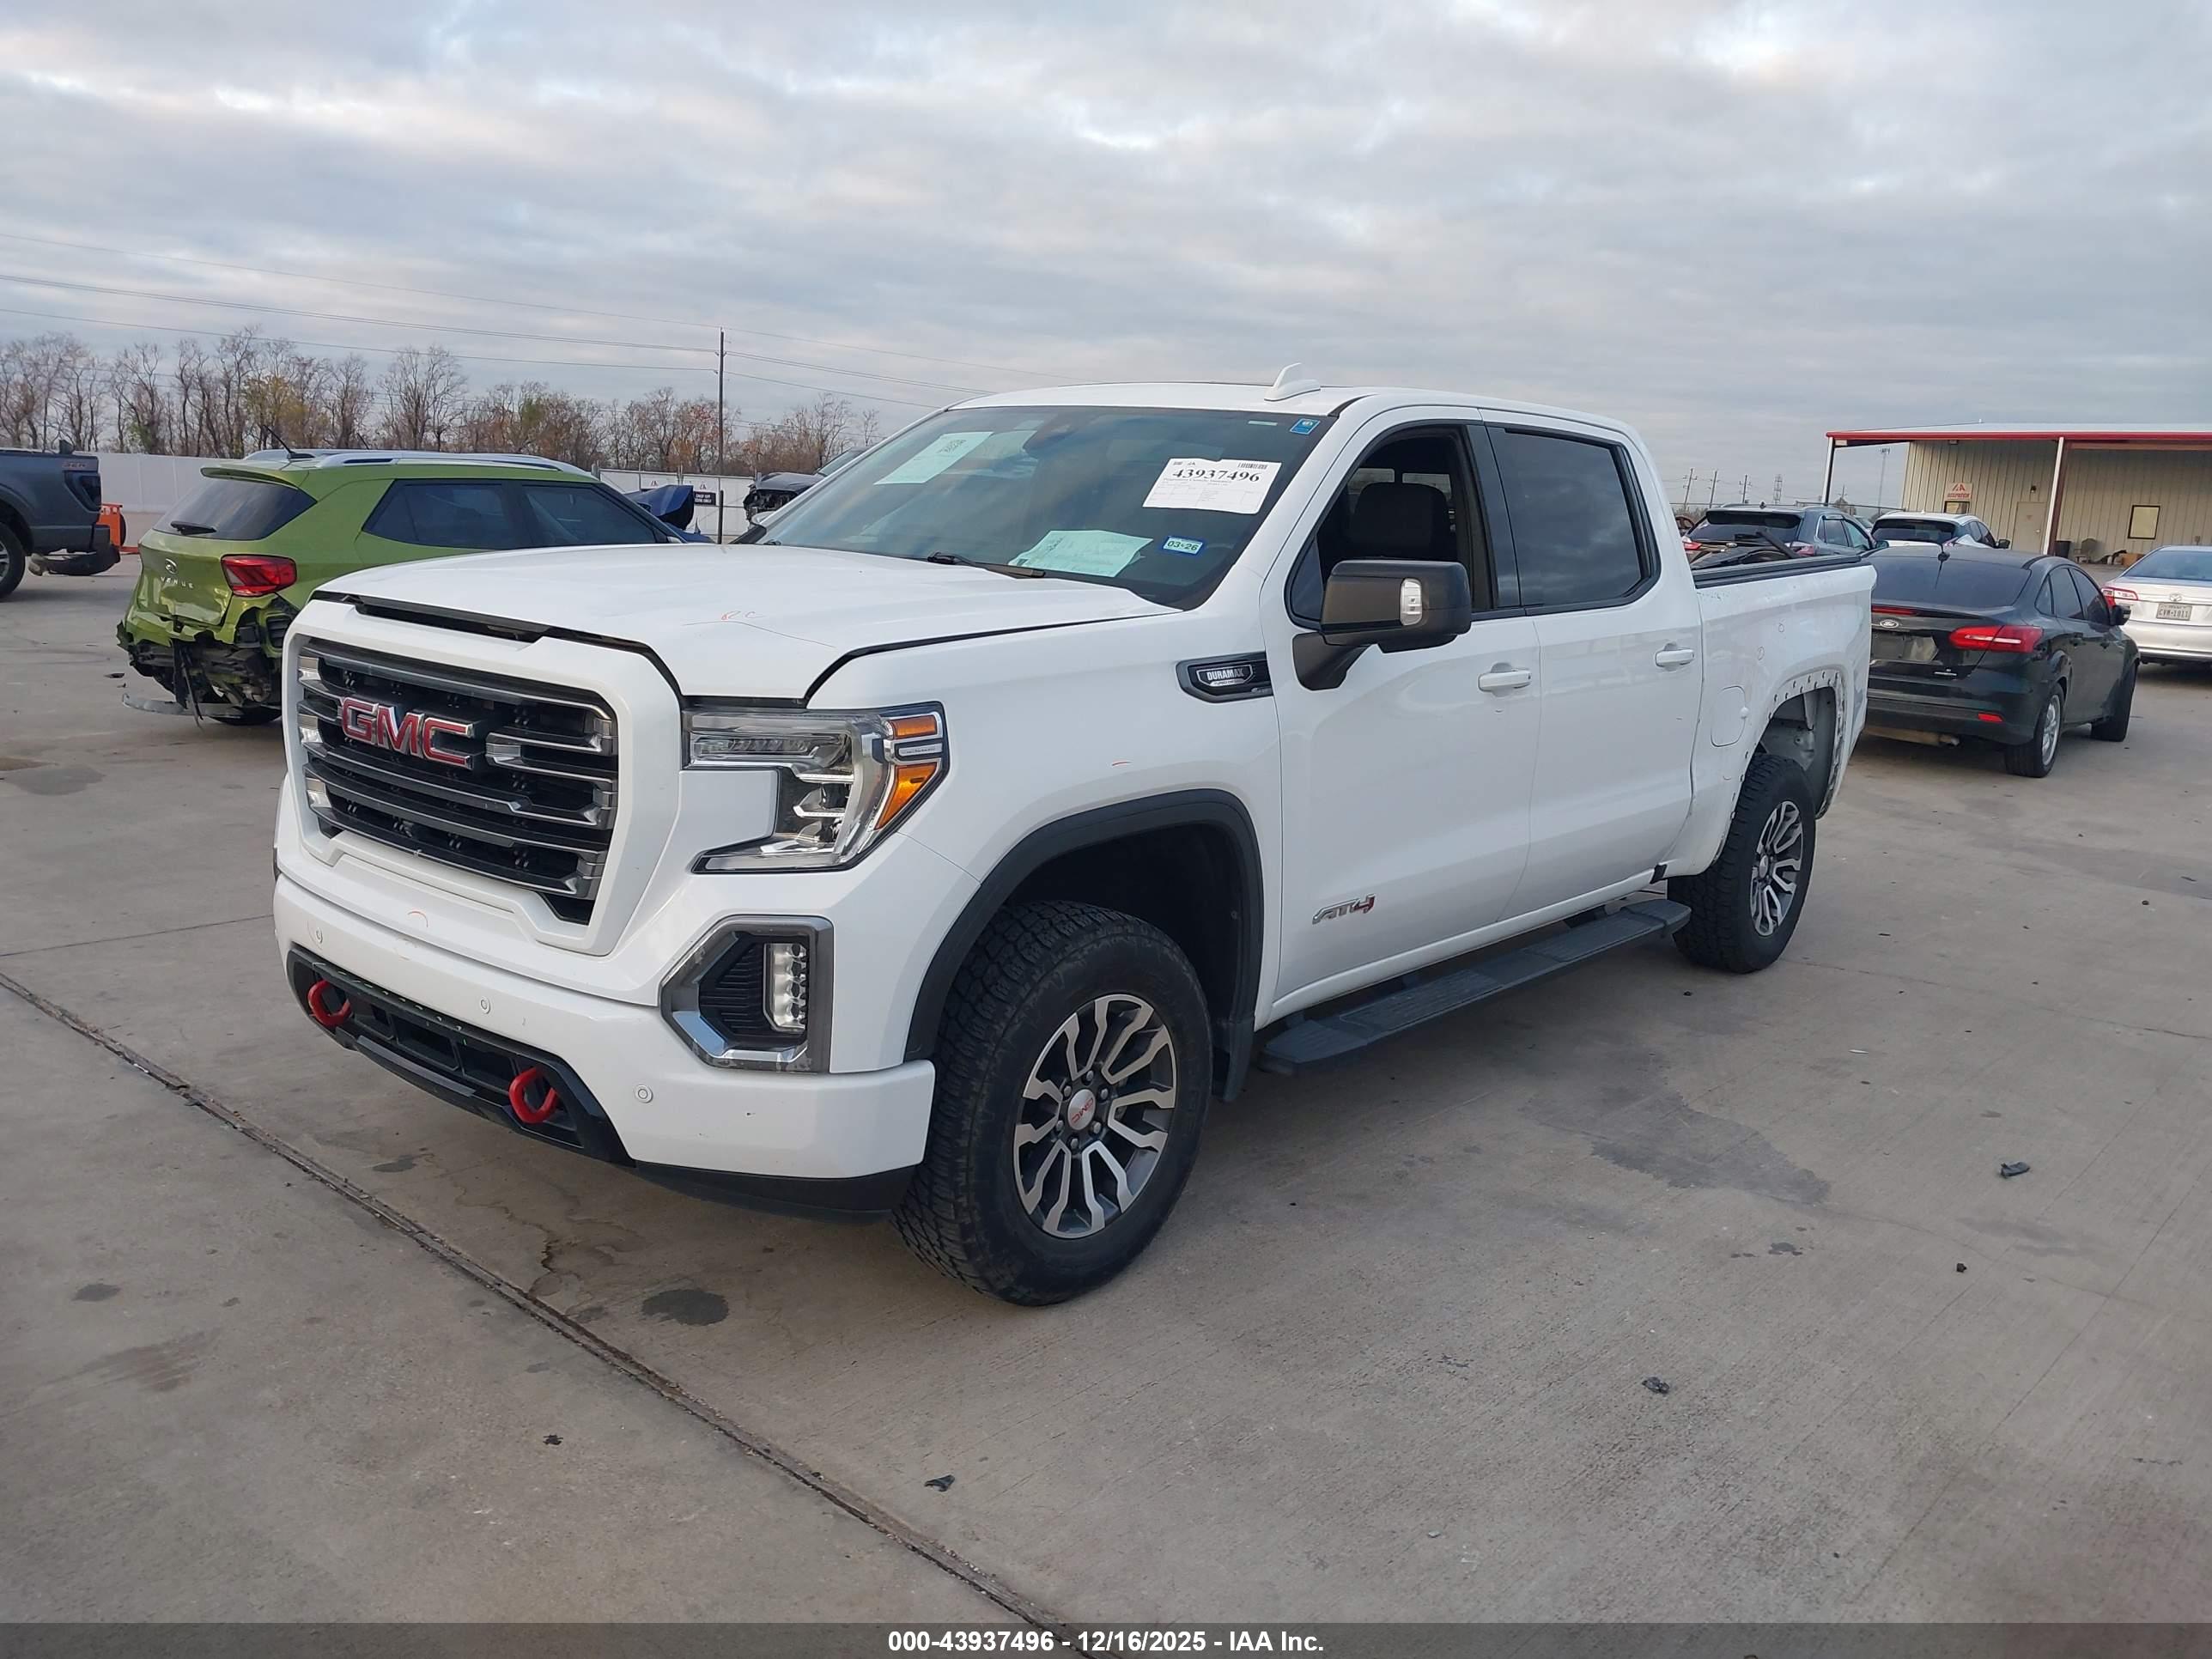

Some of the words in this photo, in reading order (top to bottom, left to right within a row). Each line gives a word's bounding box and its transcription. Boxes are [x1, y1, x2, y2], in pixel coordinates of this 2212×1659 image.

[1173, 469, 1261, 483] 43937496
[1206, 668, 1244, 681] DURAMAX
[343, 697, 475, 770] GMC
[1312, 894, 1376, 925] AT4
[1071, 1097, 1094, 1124] GMC
